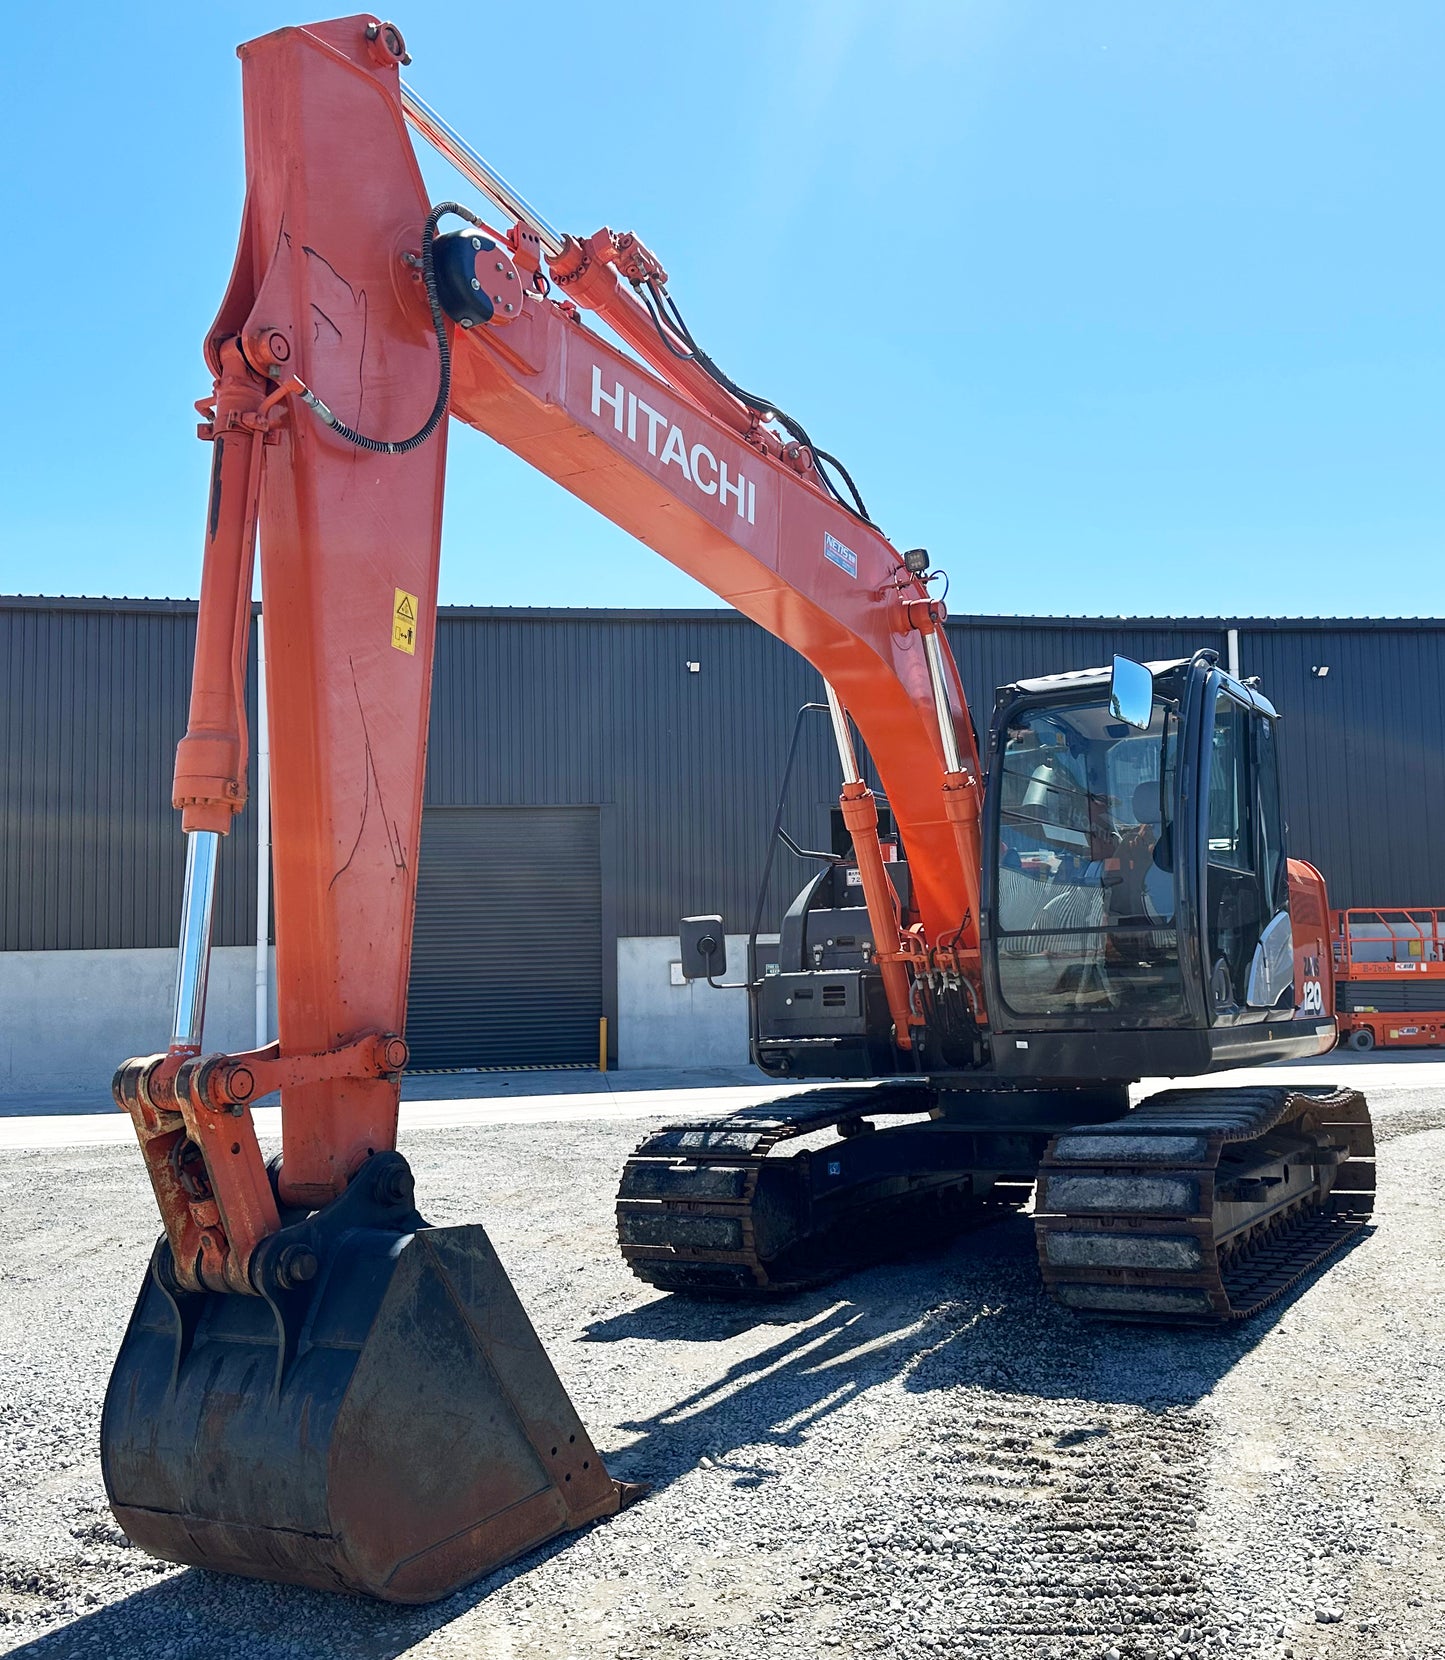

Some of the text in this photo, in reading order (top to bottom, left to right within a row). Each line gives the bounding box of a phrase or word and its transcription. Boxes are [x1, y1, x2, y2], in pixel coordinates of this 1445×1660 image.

[591, 364, 756, 526] HITACHI
[826, 535, 849, 559] NETIS
[1304, 981, 1322, 1011] 120
